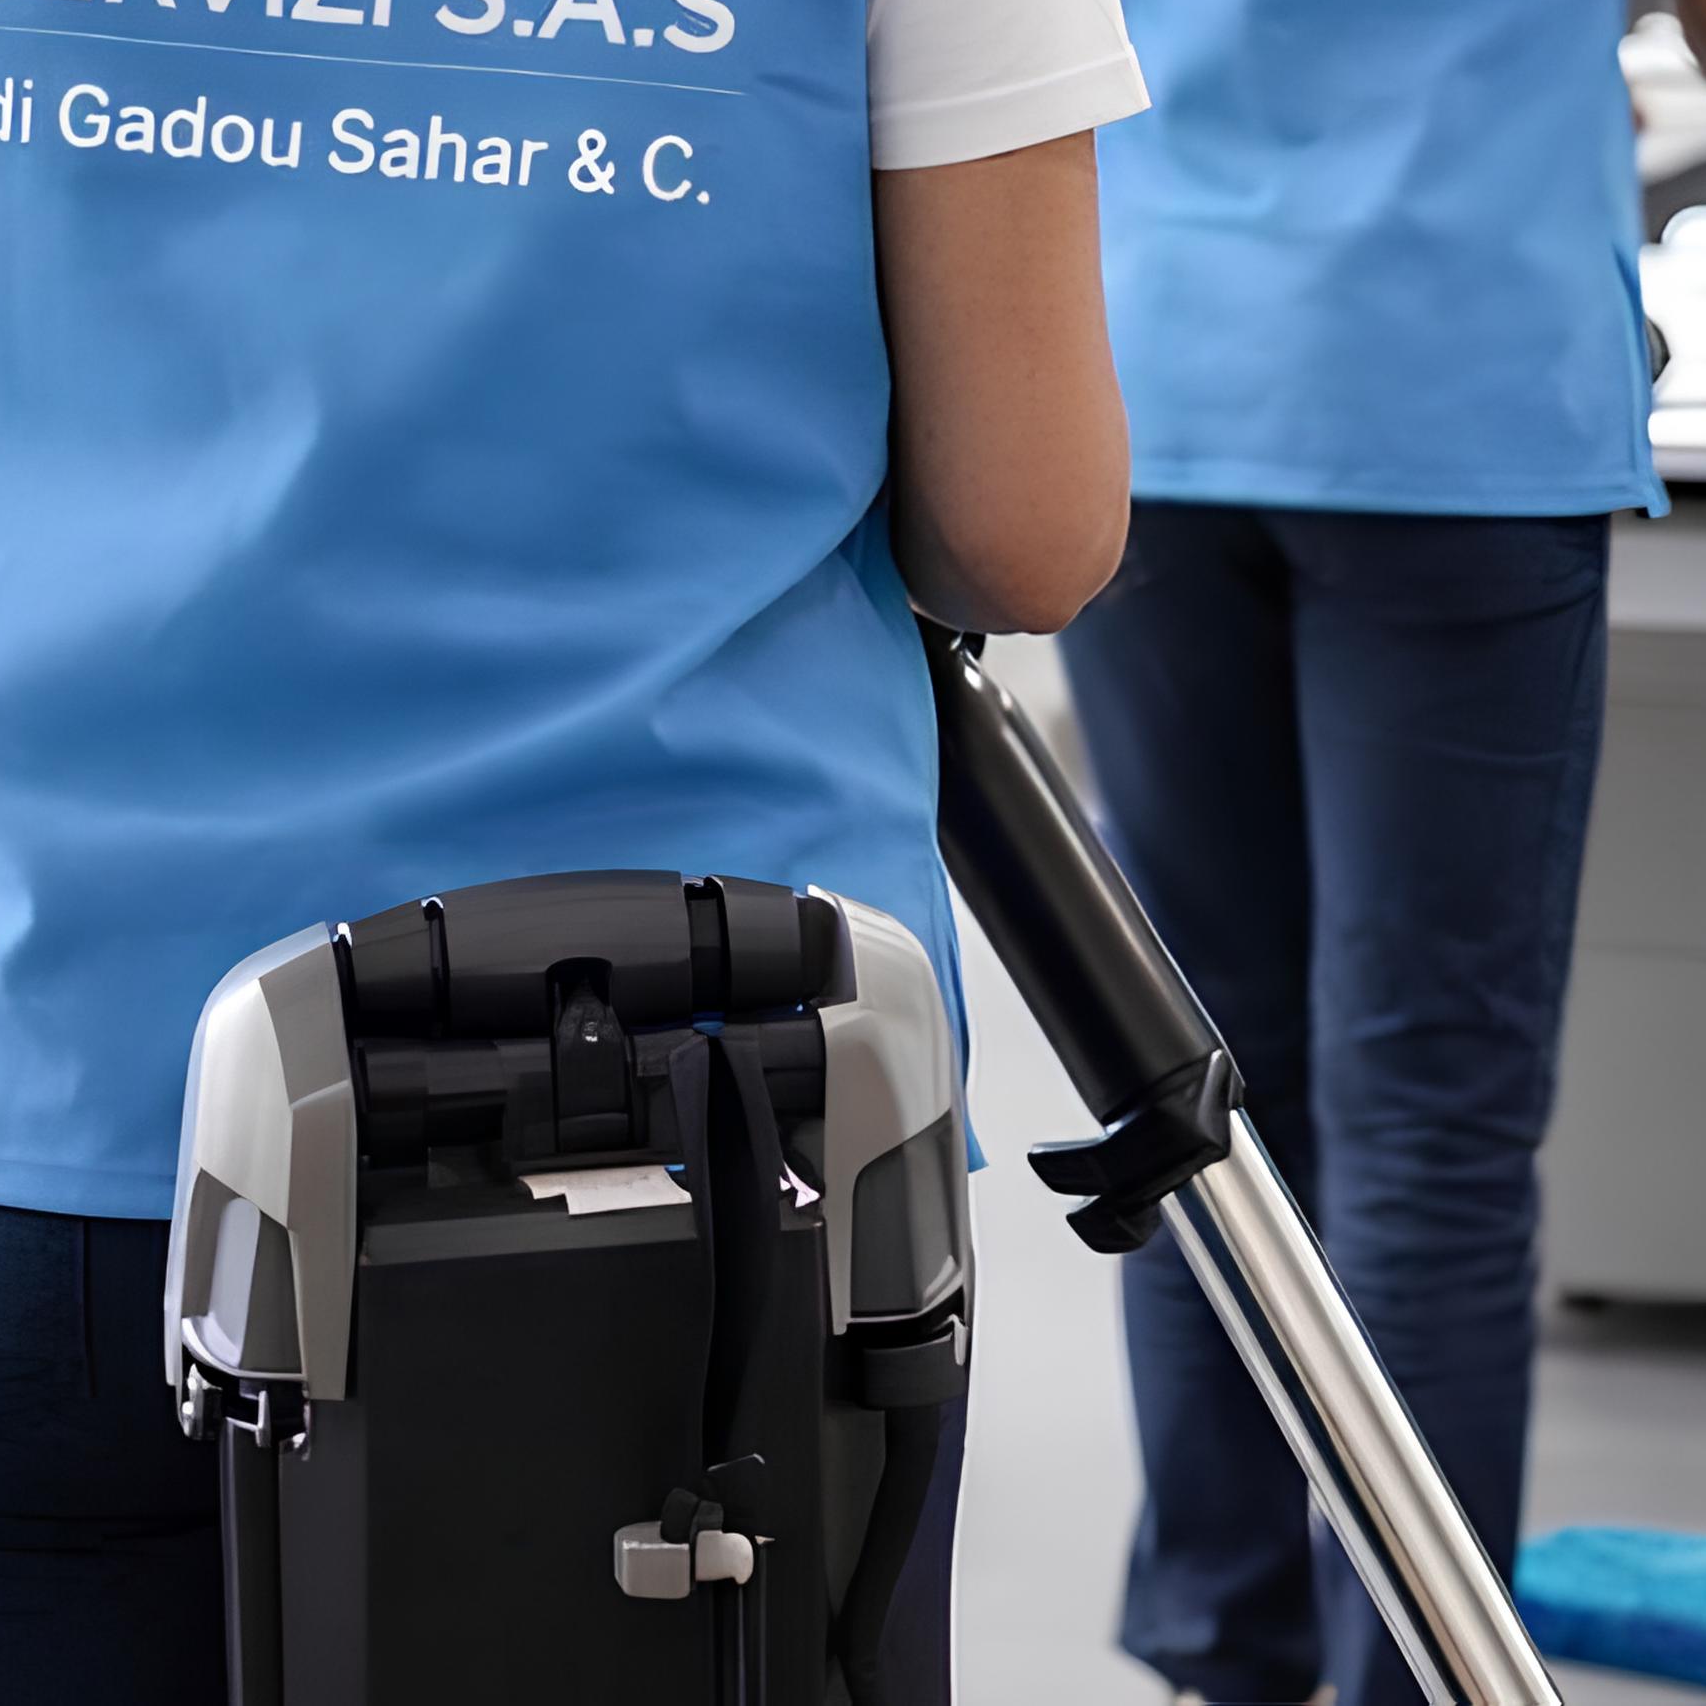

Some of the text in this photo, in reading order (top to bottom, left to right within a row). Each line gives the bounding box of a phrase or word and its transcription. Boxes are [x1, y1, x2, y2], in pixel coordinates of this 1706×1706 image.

[58, 84, 302, 168] Gadou
[328, 108, 548, 187] Sahar
[568, 128, 616, 195] &
[643, 135, 711, 204] C.
